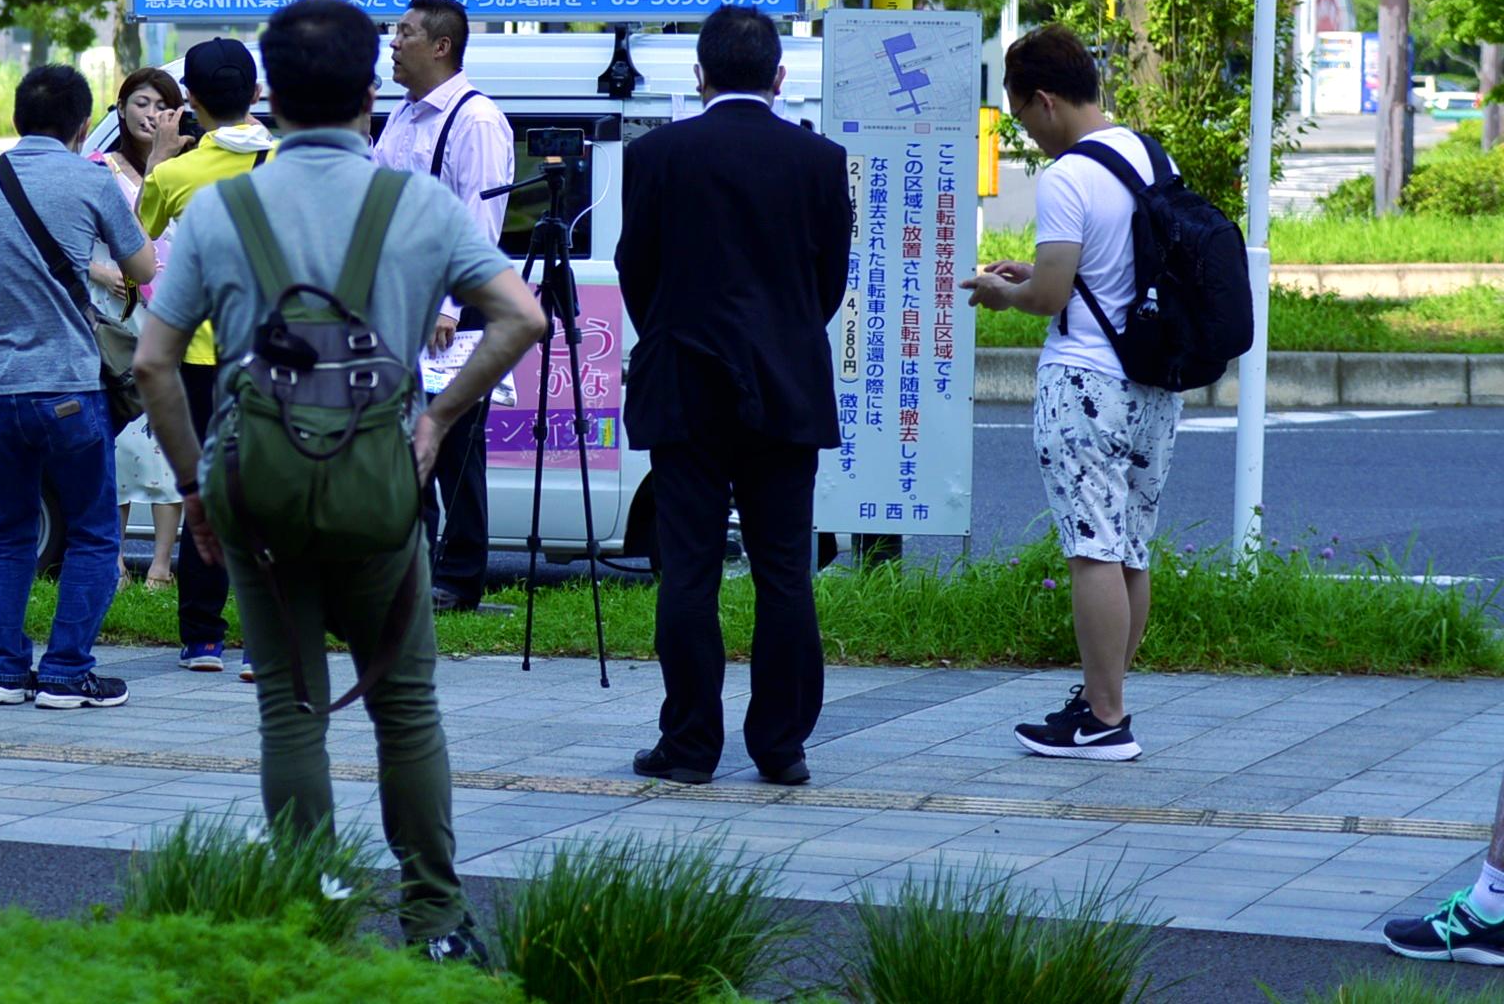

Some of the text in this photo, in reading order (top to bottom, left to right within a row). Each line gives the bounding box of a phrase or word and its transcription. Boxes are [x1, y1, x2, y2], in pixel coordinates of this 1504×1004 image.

[865, 156, 888, 432] なお撤去された自転車の返還の際には、
[898, 143, 923, 500] この区域に放置された自転車は随時撤去します。
[933, 143, 956, 400] ここは自転車等放置禁止区域です。
